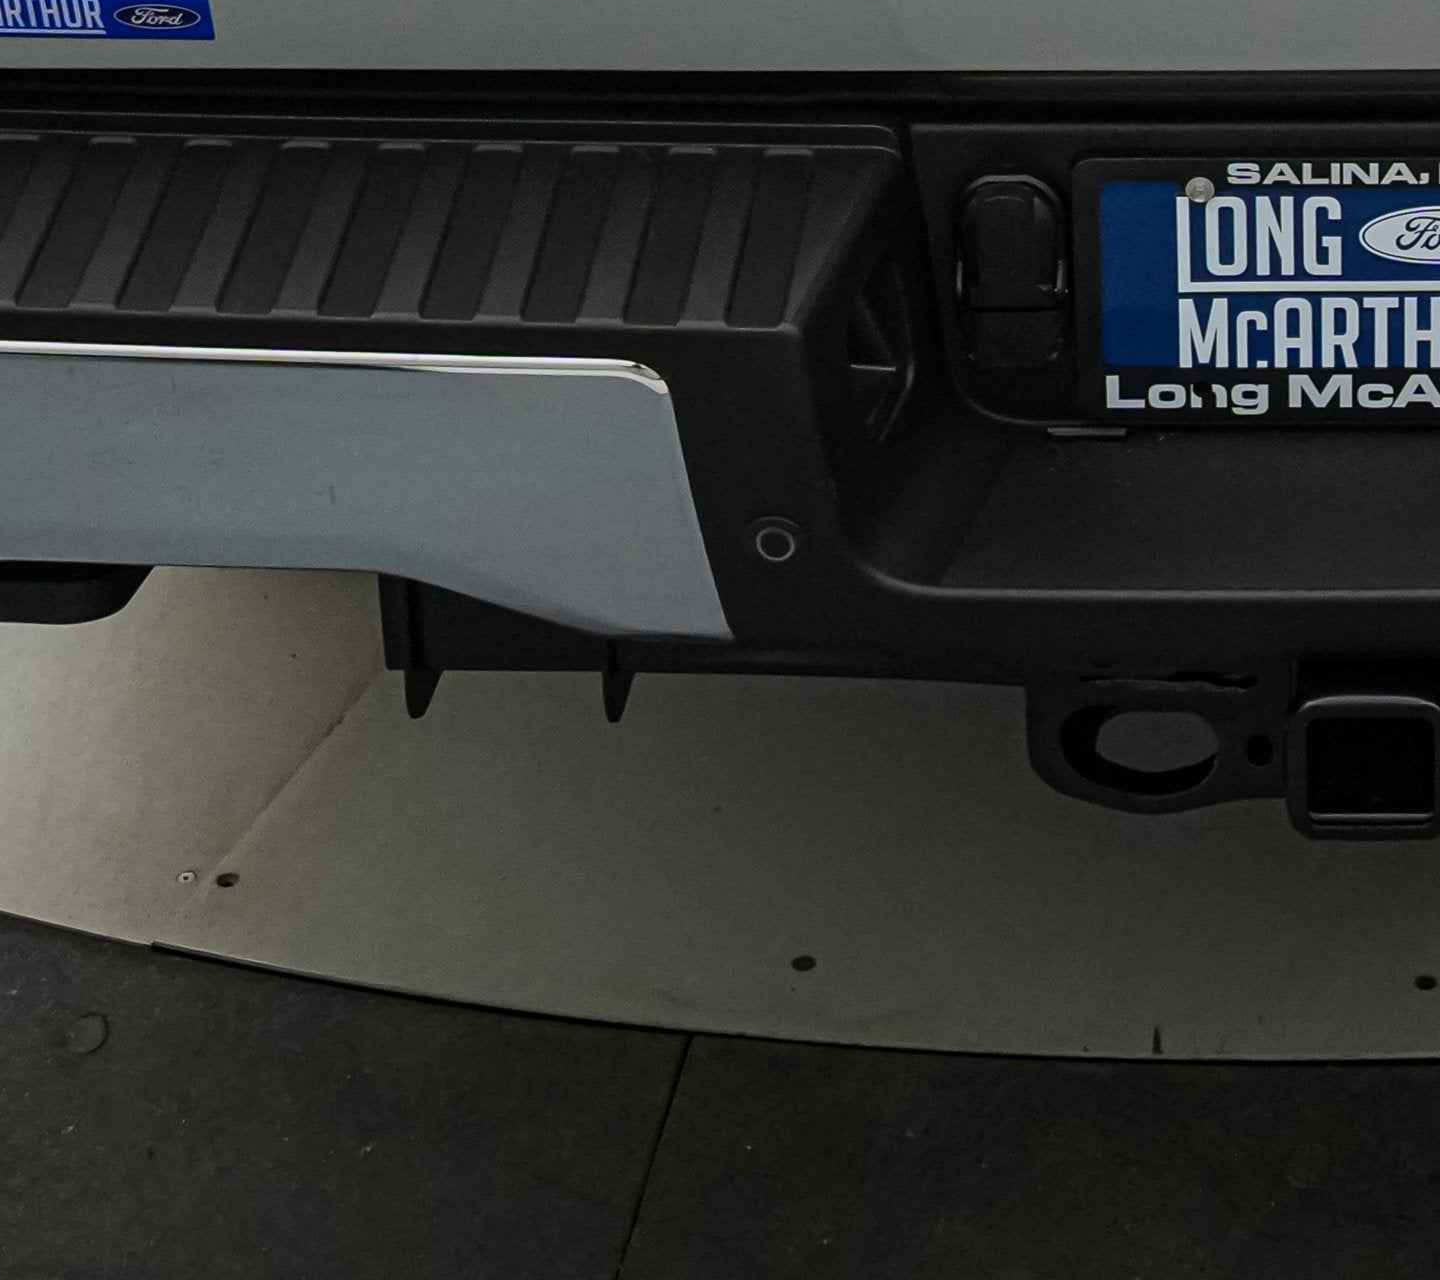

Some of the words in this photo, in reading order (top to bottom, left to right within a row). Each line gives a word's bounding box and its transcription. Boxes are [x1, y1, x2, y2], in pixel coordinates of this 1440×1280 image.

[130, 7, 184, 27] Ford
[1176, 196, 1343, 292] LONG
[1105, 374, 1270, 415] Long
